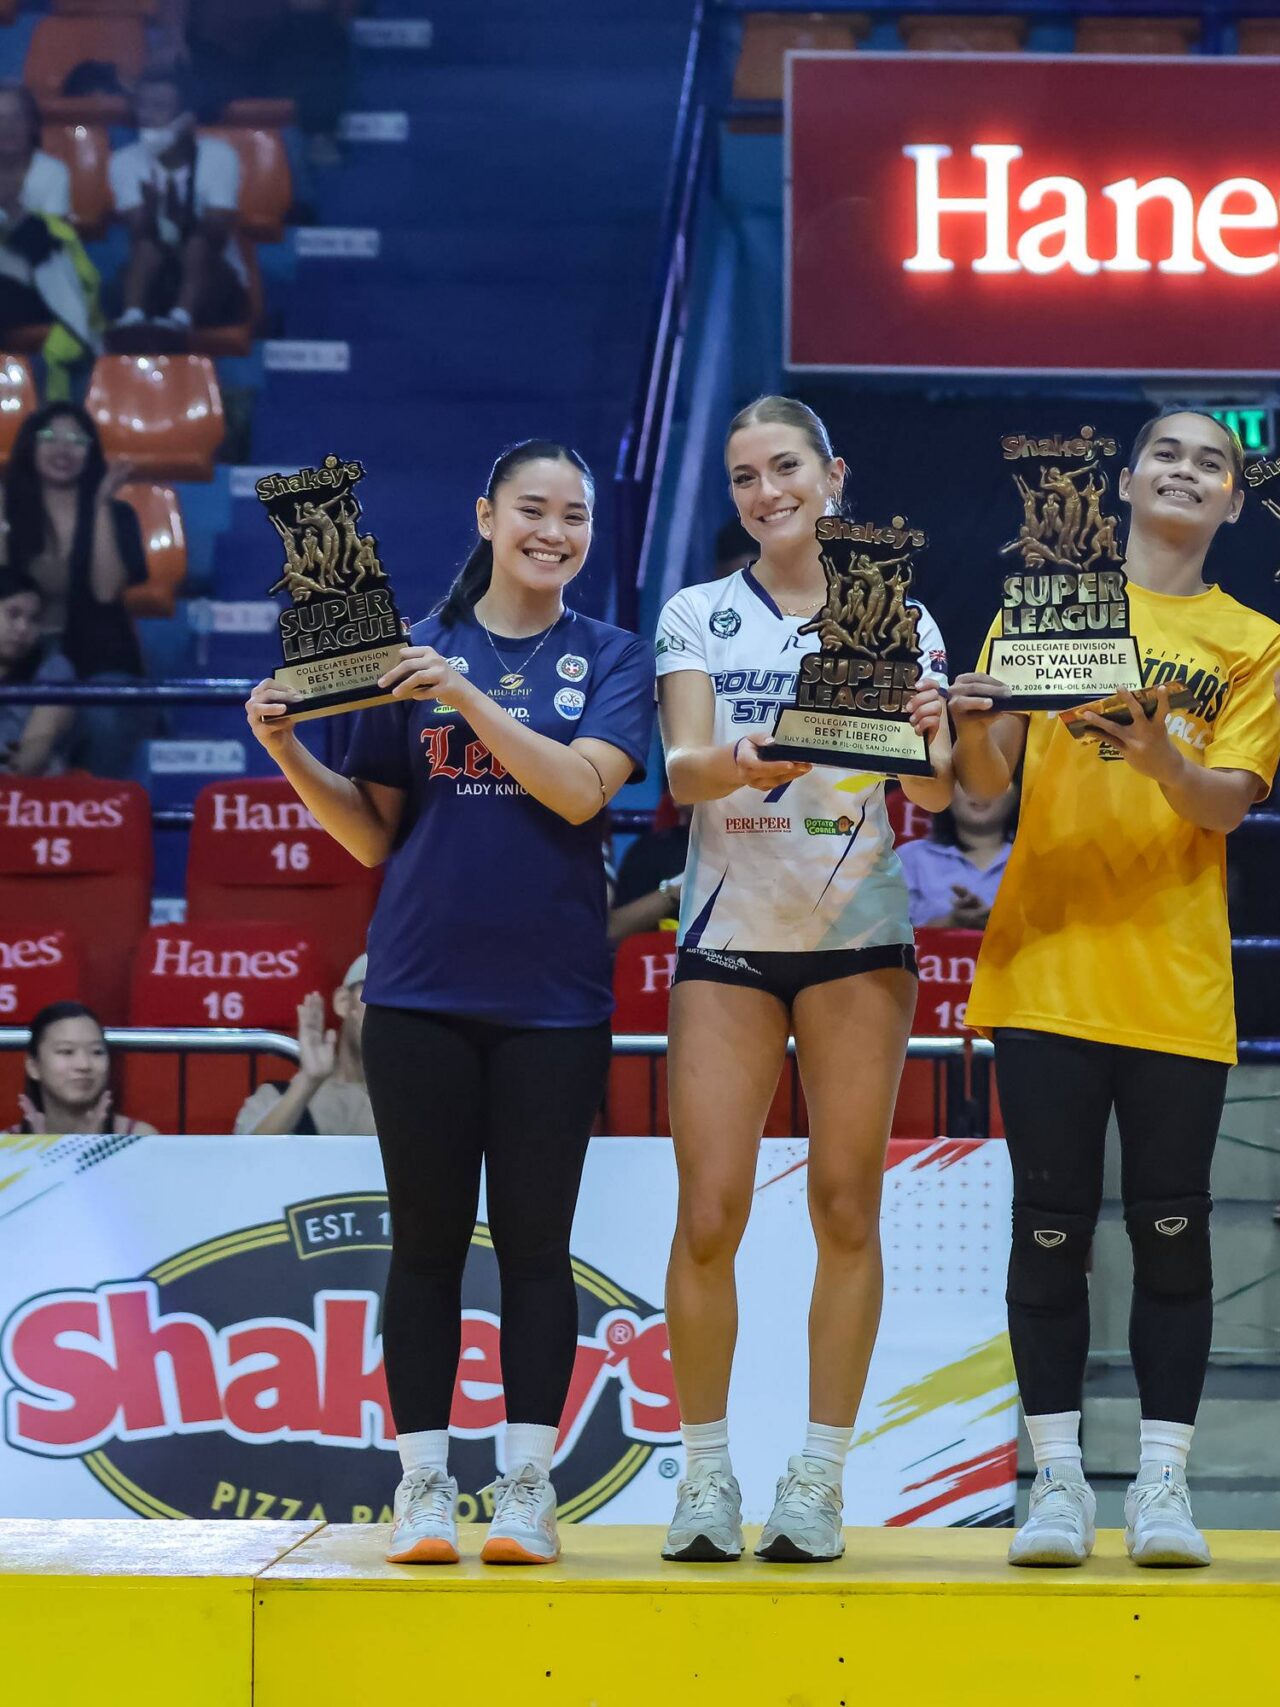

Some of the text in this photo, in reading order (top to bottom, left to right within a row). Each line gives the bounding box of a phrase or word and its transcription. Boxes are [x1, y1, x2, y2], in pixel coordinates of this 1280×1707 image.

[1001, 435, 1118, 461] Shakey's
[256, 462, 362, 500] Shakey's
[816, 517, 926, 548] Shakey's
[1003, 572, 1126, 608] SUPER
[280, 588, 394, 639] SUPER
[1003, 603, 1127, 635] LEAGUE
[282, 614, 397, 662] LEAGUE
[1012, 642, 1116, 651] COLLEGIATE DIVISION
[296, 651, 389, 676] COLLEGIATE DIVISION
[308, 671, 335, 685] BEST
[340, 662, 380, 678] SETTER
[802, 652, 920, 689] SUPER
[1001, 653, 1127, 666] MOST VALUABLE
[1035, 668, 1093, 680] PLAYER
[803, 716, 901, 733] COLLEGIATE DIVISION
[814, 727, 888, 743] BEST LIBERO
[456, 783, 492, 796] LADY
[725, 817, 791, 830] PERI-PERI
[32, 838, 72, 866] 15
[271, 842, 311, 871] 16
[151, 938, 300, 979] Hanes
[686, 948, 723, 960] AUSTRALIAN
[705, 956, 738, 971] ACADEMY
[203, 992, 244, 1020] 16
[305, 1214, 363, 1242] EST.
[211, 1480, 327, 1520] PIZZA
